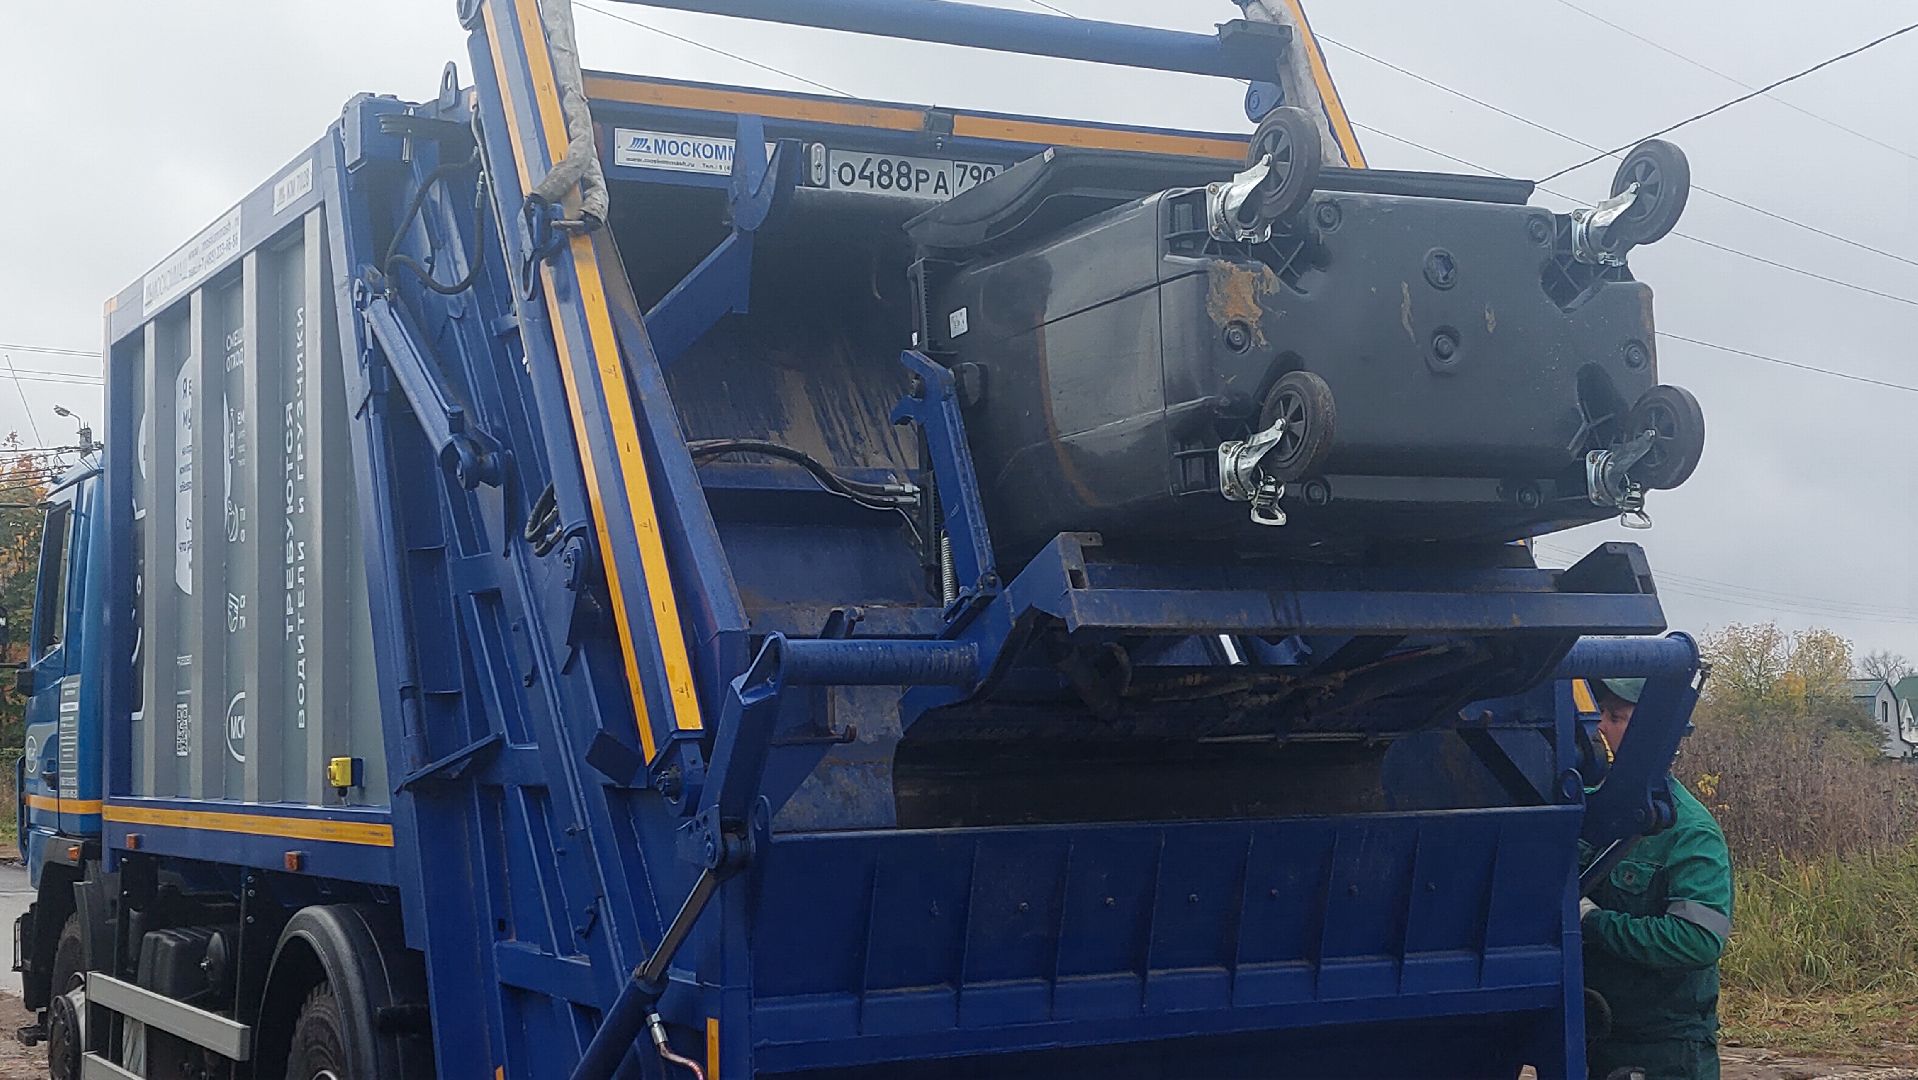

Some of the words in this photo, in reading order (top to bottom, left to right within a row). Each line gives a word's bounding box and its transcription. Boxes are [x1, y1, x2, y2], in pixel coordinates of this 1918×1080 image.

[837, 157, 949, 196] О488РА
[296, 307, 304, 480] ГРУЗЧИКИ
[286, 402, 294, 641] ТРЕБУЮТСЯ
[297, 541, 306, 729] ВОДИТЕЛИ
